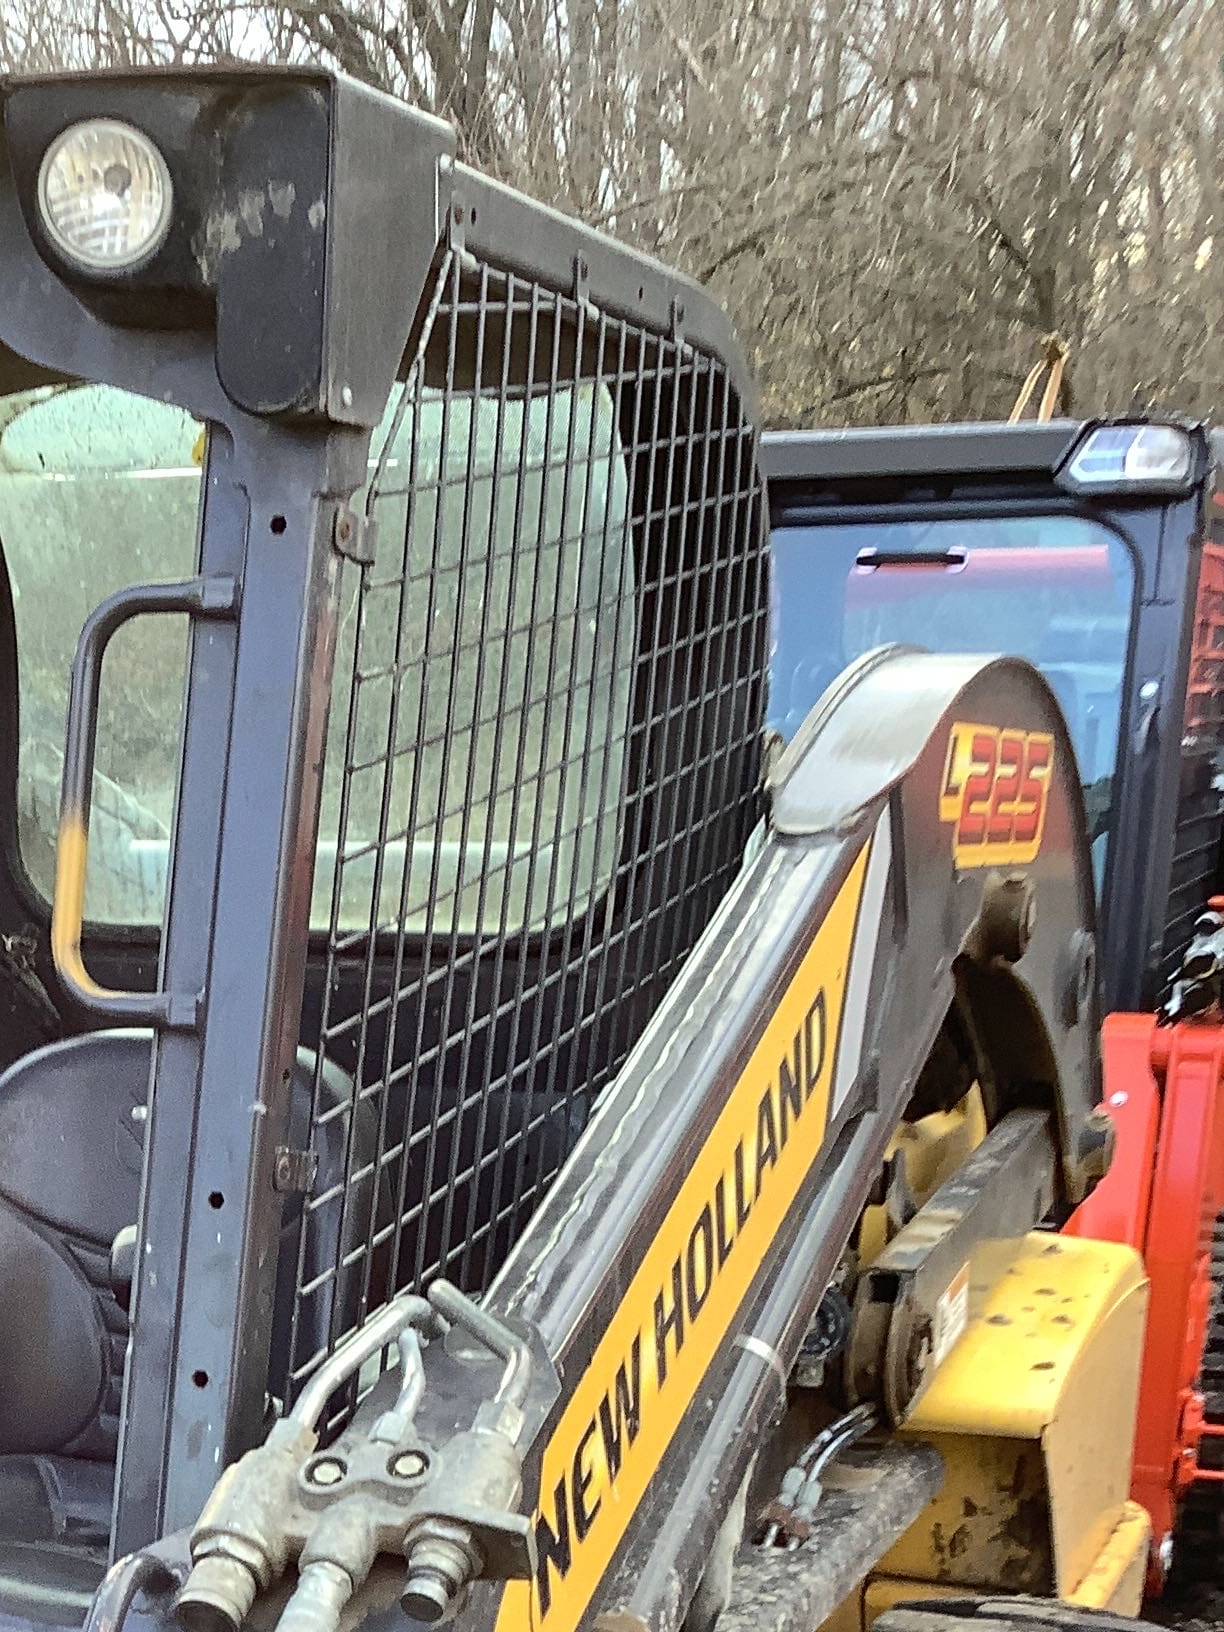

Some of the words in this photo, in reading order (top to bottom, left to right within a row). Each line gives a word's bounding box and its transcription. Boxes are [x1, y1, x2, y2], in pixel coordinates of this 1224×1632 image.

[939, 721, 1055, 870] L225
[533, 1326, 642, 1620] NEW
[653, 986, 828, 1394] HOLLAND
